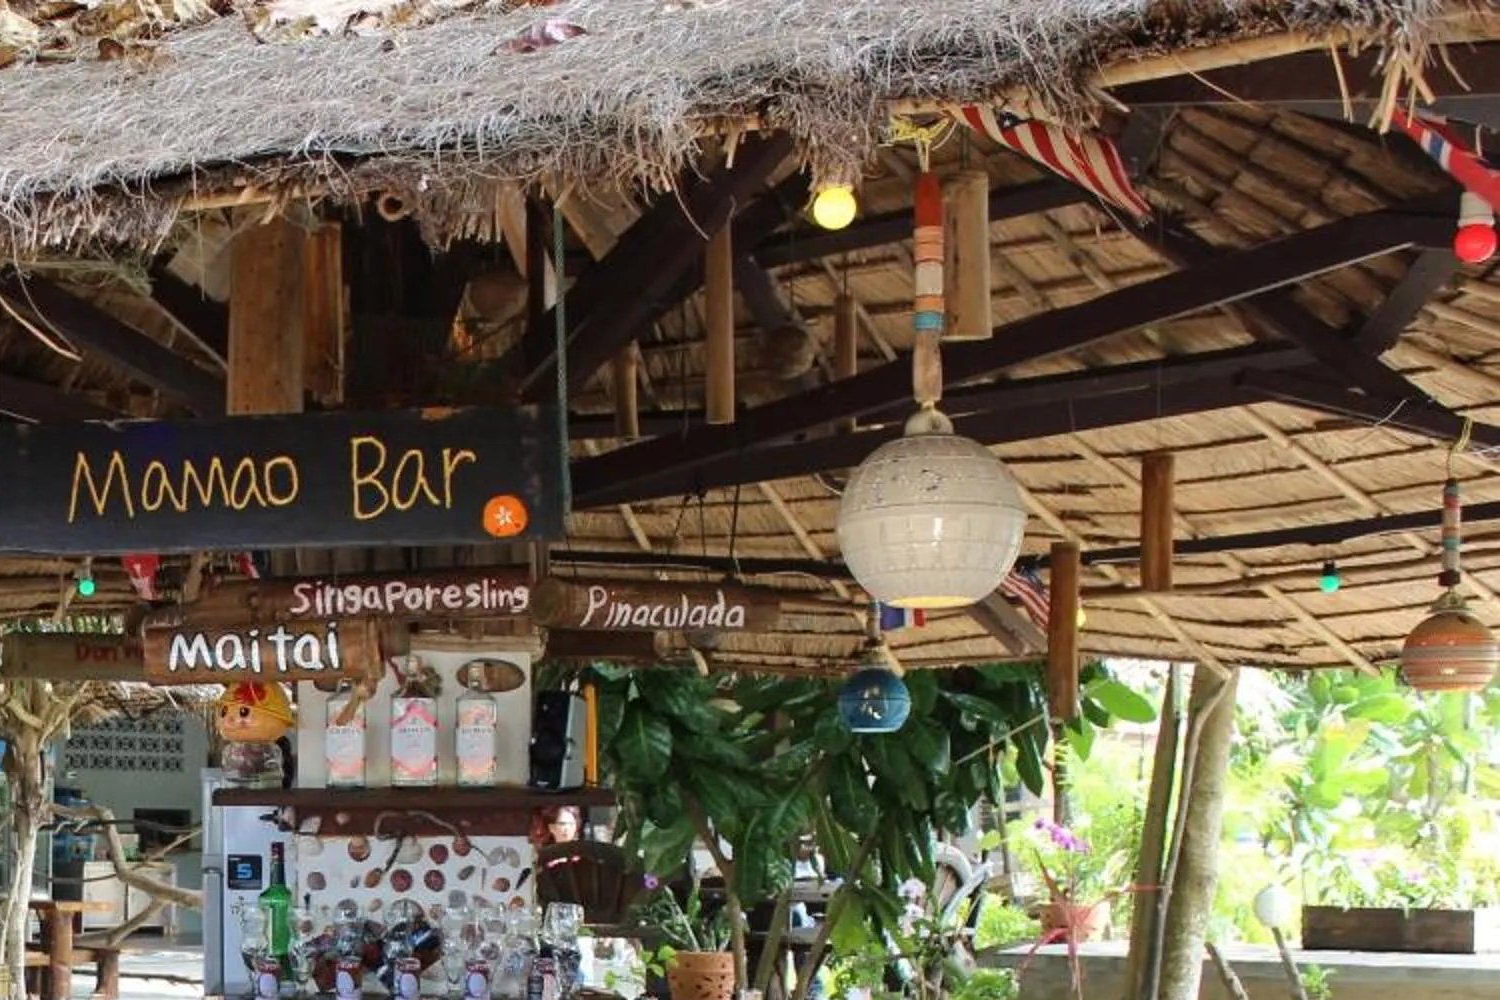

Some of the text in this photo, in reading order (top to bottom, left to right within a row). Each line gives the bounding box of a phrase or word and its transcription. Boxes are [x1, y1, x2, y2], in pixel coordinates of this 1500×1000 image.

[67, 435, 477, 523] Mamao Bar
[579, 585, 746, 628] Pinaculada
[267, 620, 341, 673] tai
